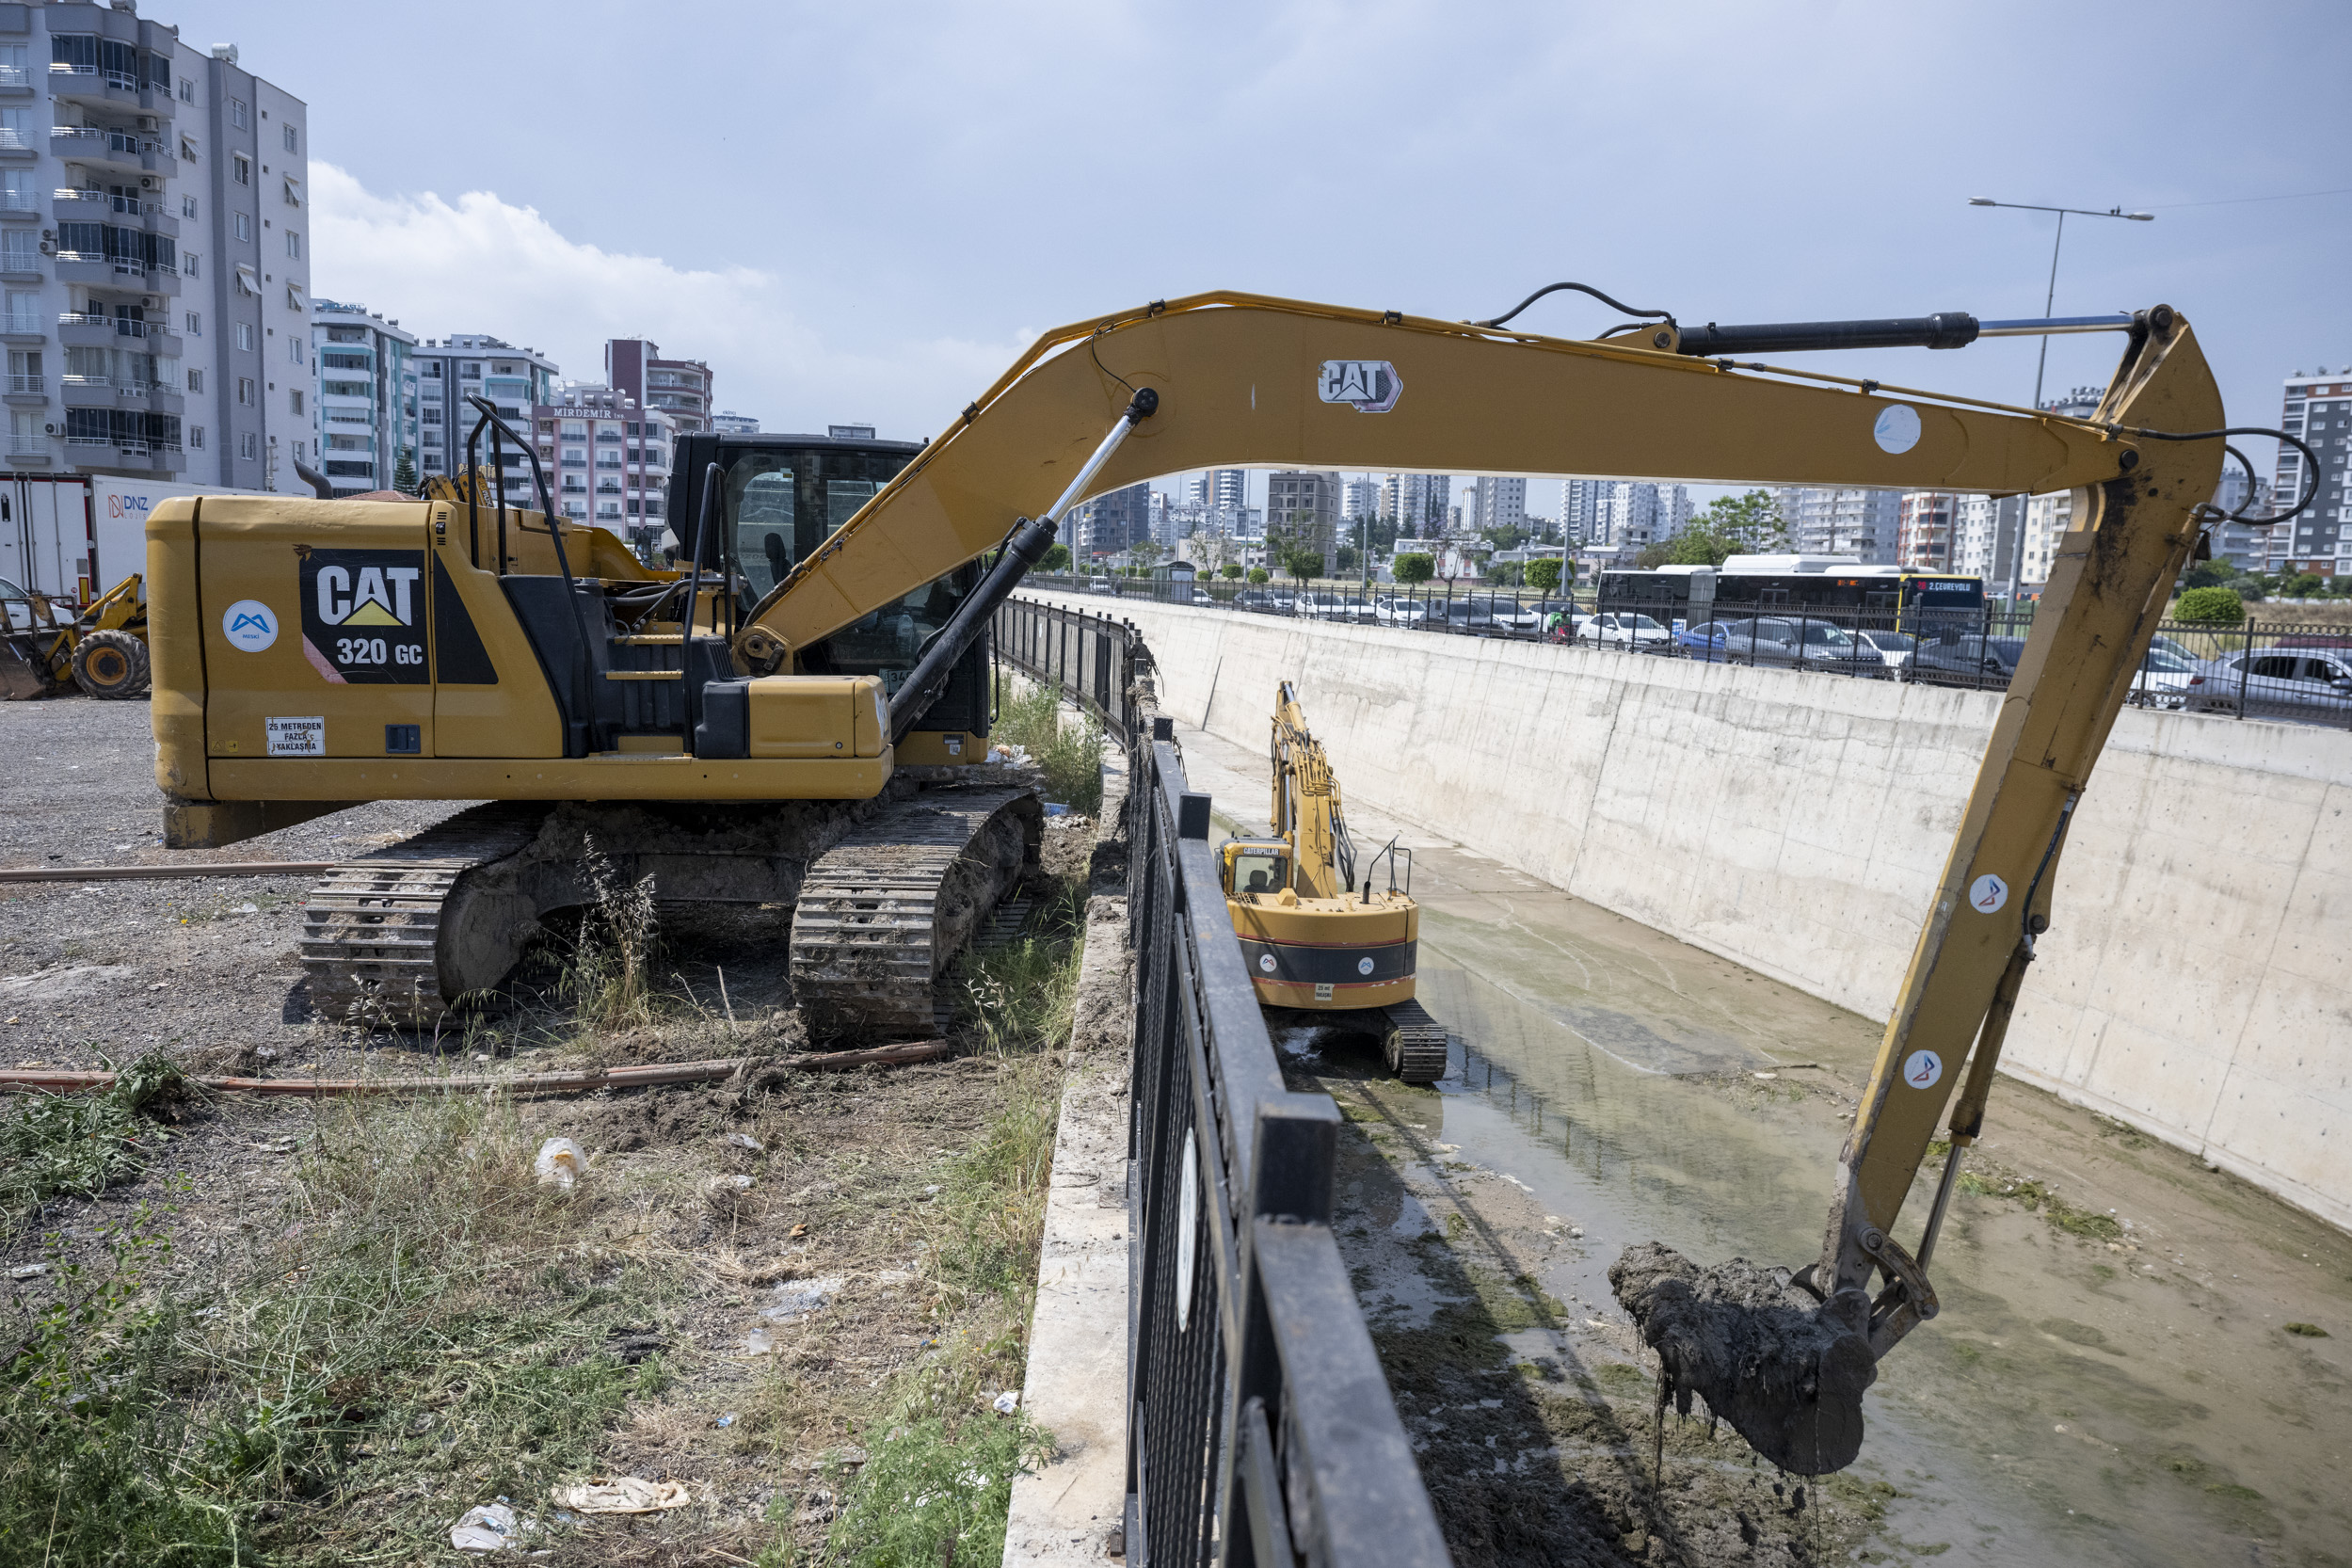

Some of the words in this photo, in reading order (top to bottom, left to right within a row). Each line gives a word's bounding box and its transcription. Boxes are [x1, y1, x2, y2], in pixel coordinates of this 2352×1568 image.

[1318, 362, 1381, 400] CAT
[553, 407, 612, 419] MİRDEMİR
[123, 495, 148, 511] DNZ
[317, 566, 419, 626] CAT
[336, 638, 387, 664] 320
[395, 645, 423, 664] GC
[1243, 847, 1279, 856] CATERPILLAR
